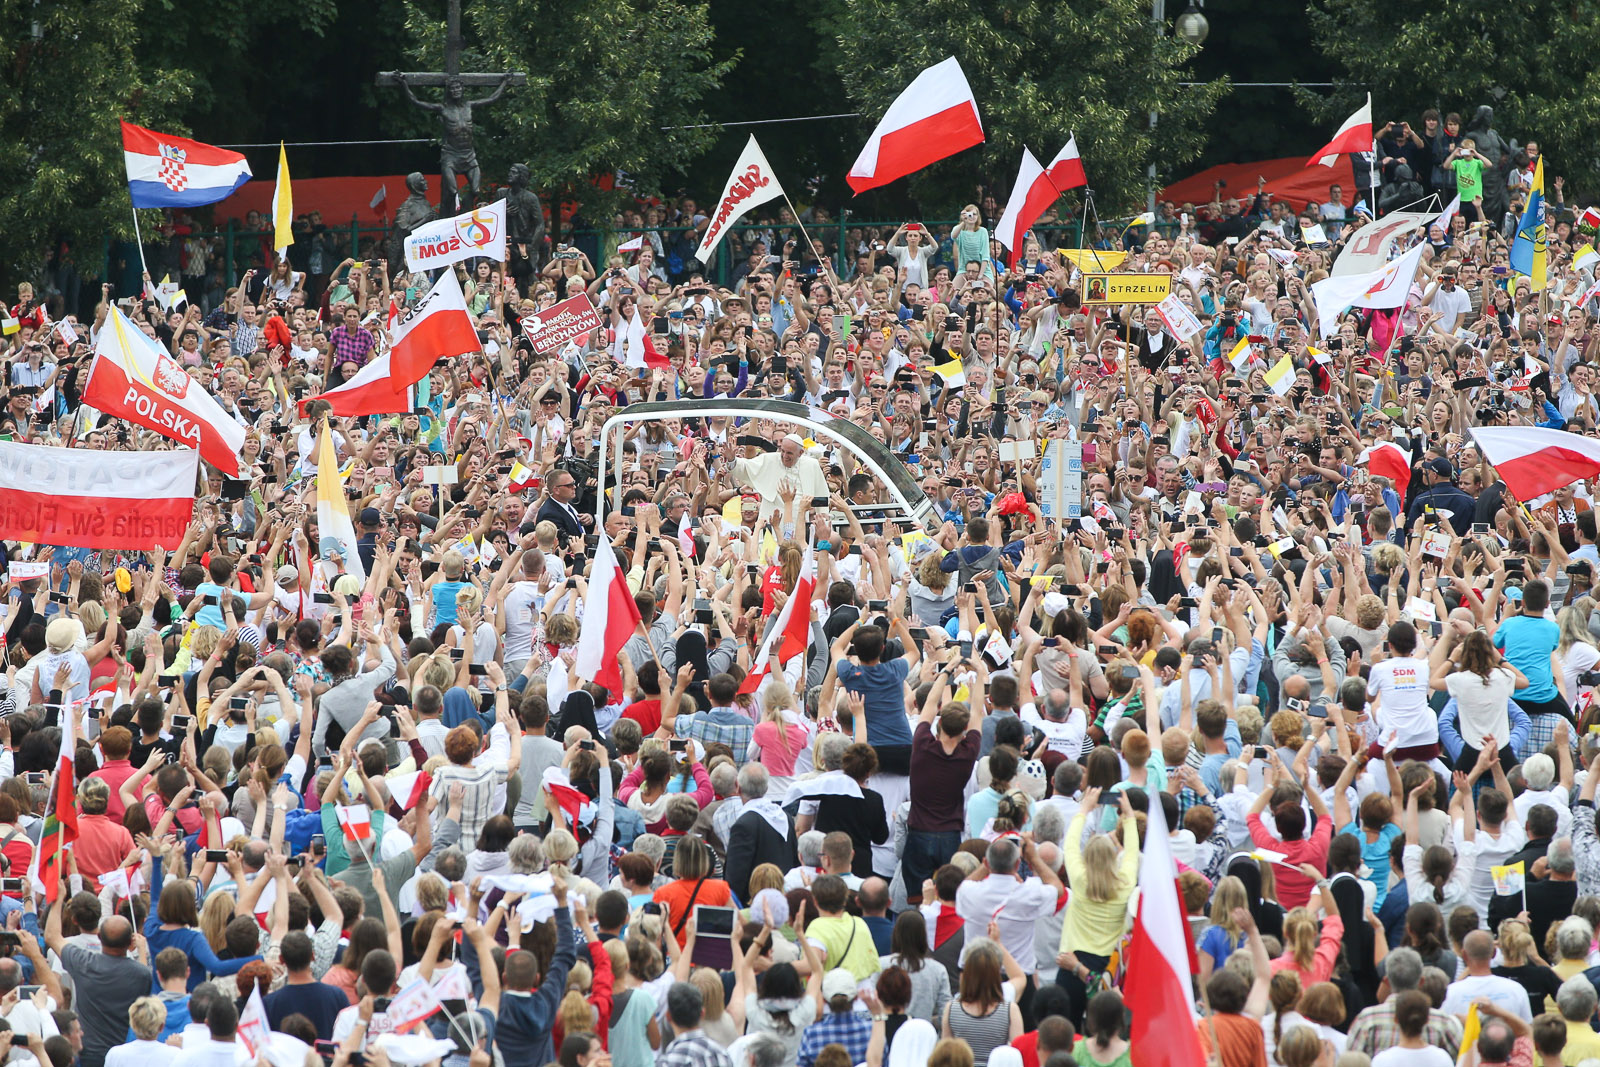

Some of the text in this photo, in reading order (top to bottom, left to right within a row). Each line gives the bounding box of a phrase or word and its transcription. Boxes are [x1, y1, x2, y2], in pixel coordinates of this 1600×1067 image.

[1110, 285, 1166, 293] STRZELIN
[545, 311, 573, 326] PARAFIA
[560, 314, 583, 328] DUCHA
[536, 317, 597, 350] BEŁCHATÓW
[123, 386, 202, 442] POLSKA
